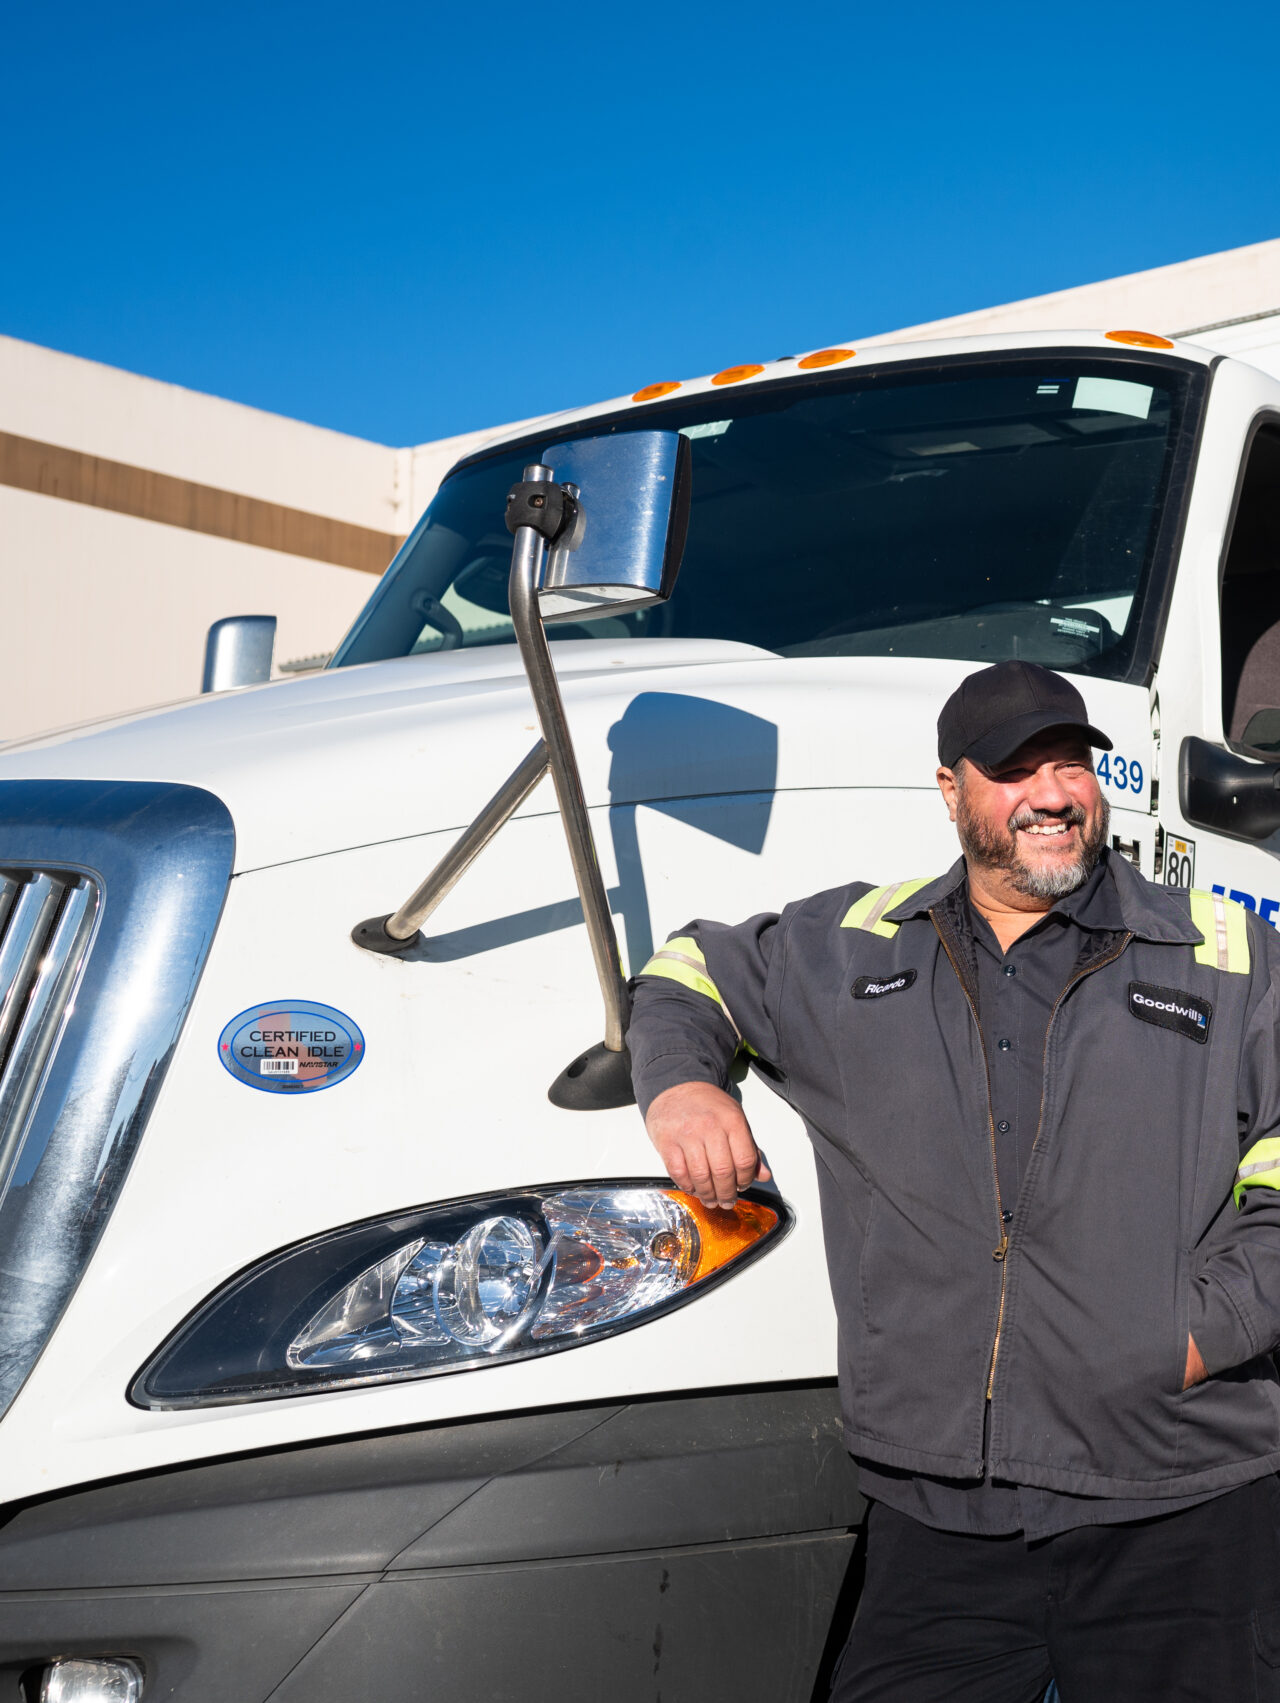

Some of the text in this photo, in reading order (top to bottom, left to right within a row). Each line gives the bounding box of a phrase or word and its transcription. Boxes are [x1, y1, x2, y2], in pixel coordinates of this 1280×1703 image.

[1096, 753, 1143, 794] 439
[864, 978, 906, 994] Ricardo
[1132, 993, 1198, 1021] Goodwill
[249, 1031, 336, 1042] CERTIFIED
[240, 1046, 344, 1058] CLEAN IDLE
